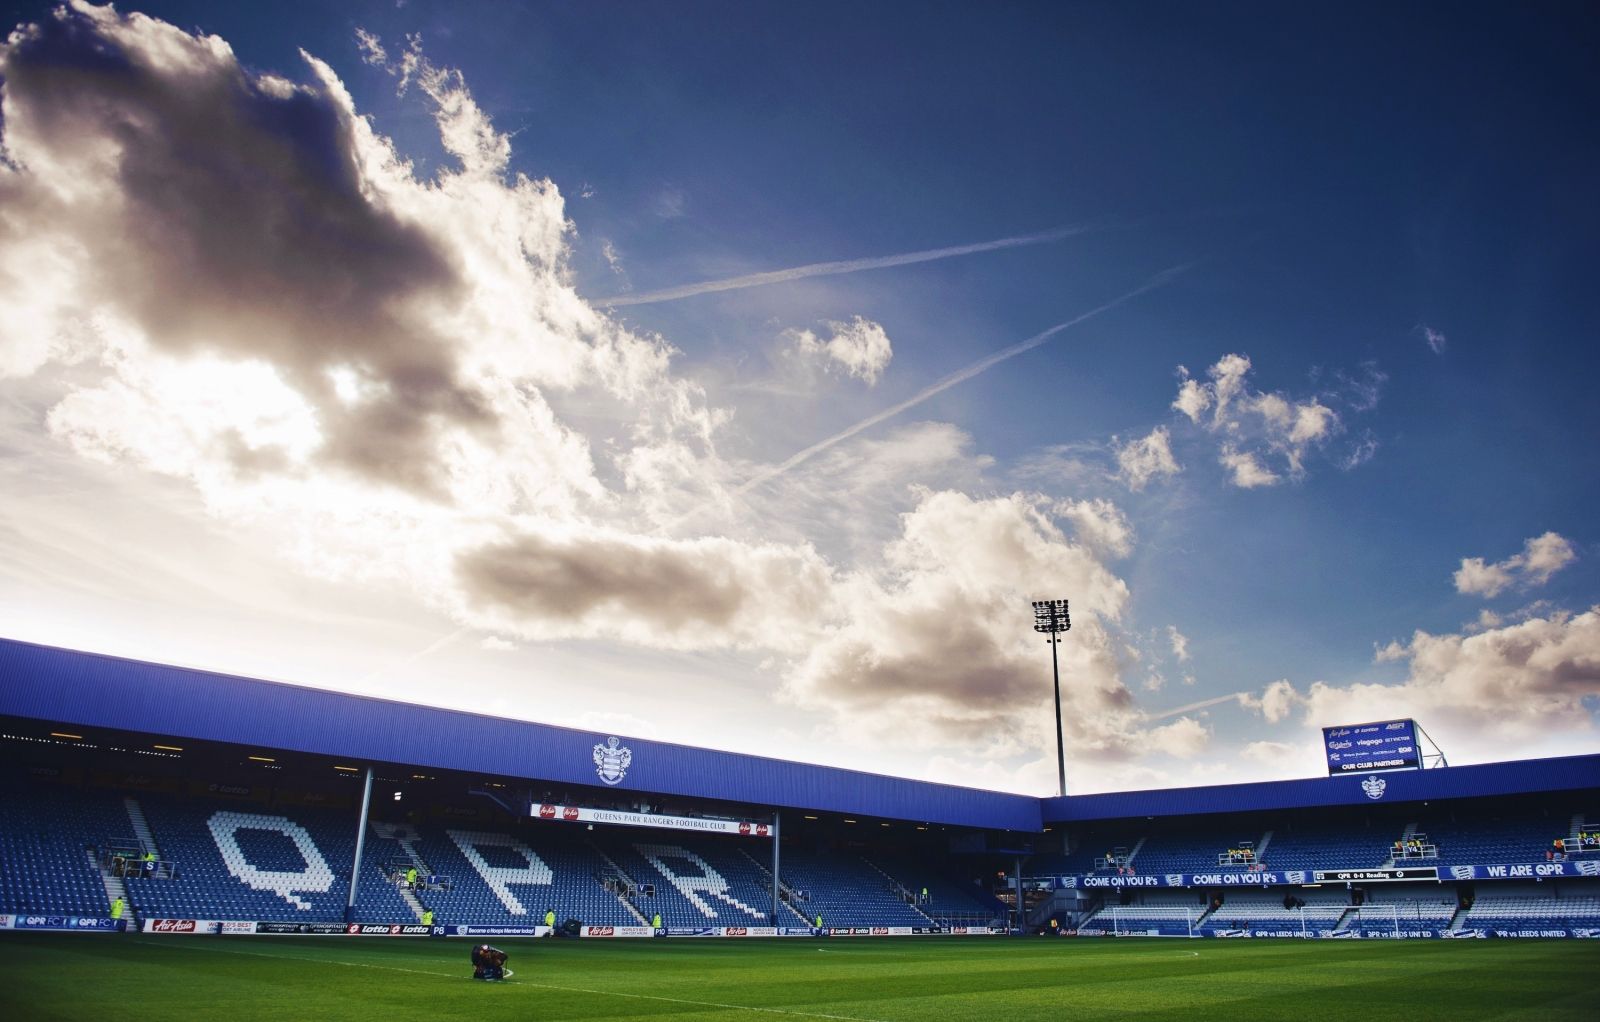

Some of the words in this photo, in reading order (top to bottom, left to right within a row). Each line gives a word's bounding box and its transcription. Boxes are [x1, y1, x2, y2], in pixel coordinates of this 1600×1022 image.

[1374, 759, 1404, 767] PARTNERS
[593, 812, 622, 821] QUEENS
[624, 814, 641, 823] PARK
[643, 816, 674, 825] RANGERS
[676, 819, 708, 829] FOOTBALL
[710, 822, 726, 830] CLUB
[146, 861, 154, 870] S
[206, 811, 335, 910] Q
[445, 829, 554, 916] P
[631, 842, 766, 918] R
[1487, 866, 1507, 877] WE
[1509, 865, 1532, 876] ARE
[1536, 864, 1564, 876] QPR
[1084, 877, 1110, 886] COME
[1111, 877, 1125, 886] ON
[1126, 876, 1144, 886] YOU
[1145, 876, 1158, 885] R's
[1193, 875, 1222, 884] COME
[1223, 874, 1239, 883] ON
[1240, 873, 1260, 883] YOU
[1263, 873, 1277, 883] R's
[26, 916, 46, 925] QPR
[47, 917, 60, 926] FC
[78, 918, 98, 926] QPR
[98, 919, 110, 927] FC
[433, 926, 445, 934] P8
